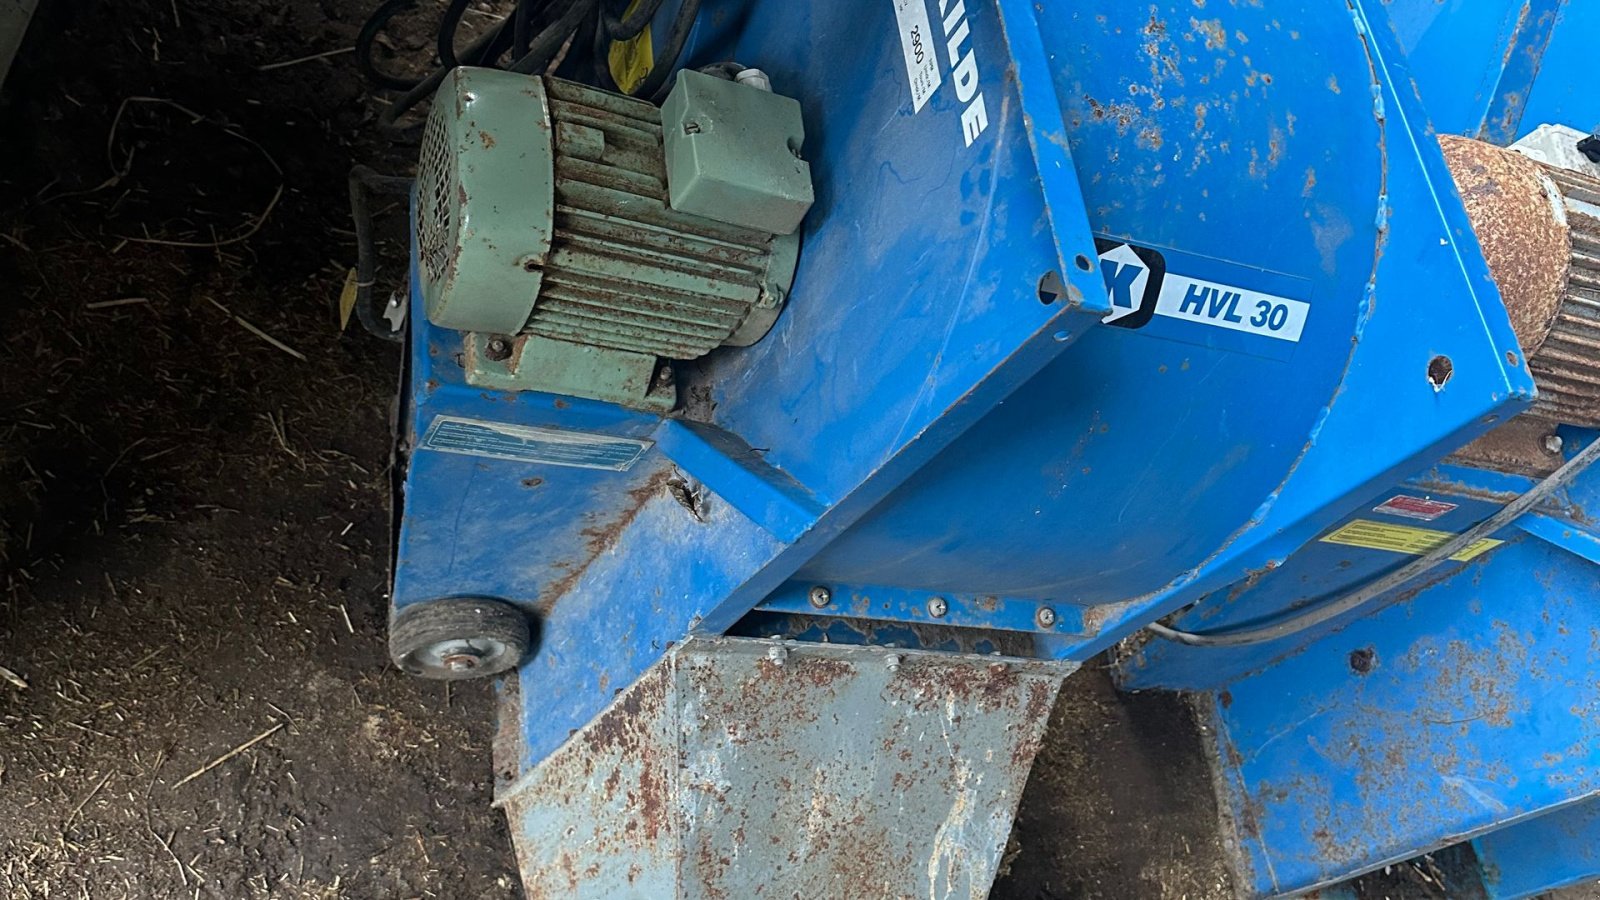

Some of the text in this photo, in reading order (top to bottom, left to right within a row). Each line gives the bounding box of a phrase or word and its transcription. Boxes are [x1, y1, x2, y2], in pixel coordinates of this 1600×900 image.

[911, 25, 924, 64] 2900
[1178, 283, 1289, 331] HVL 30
